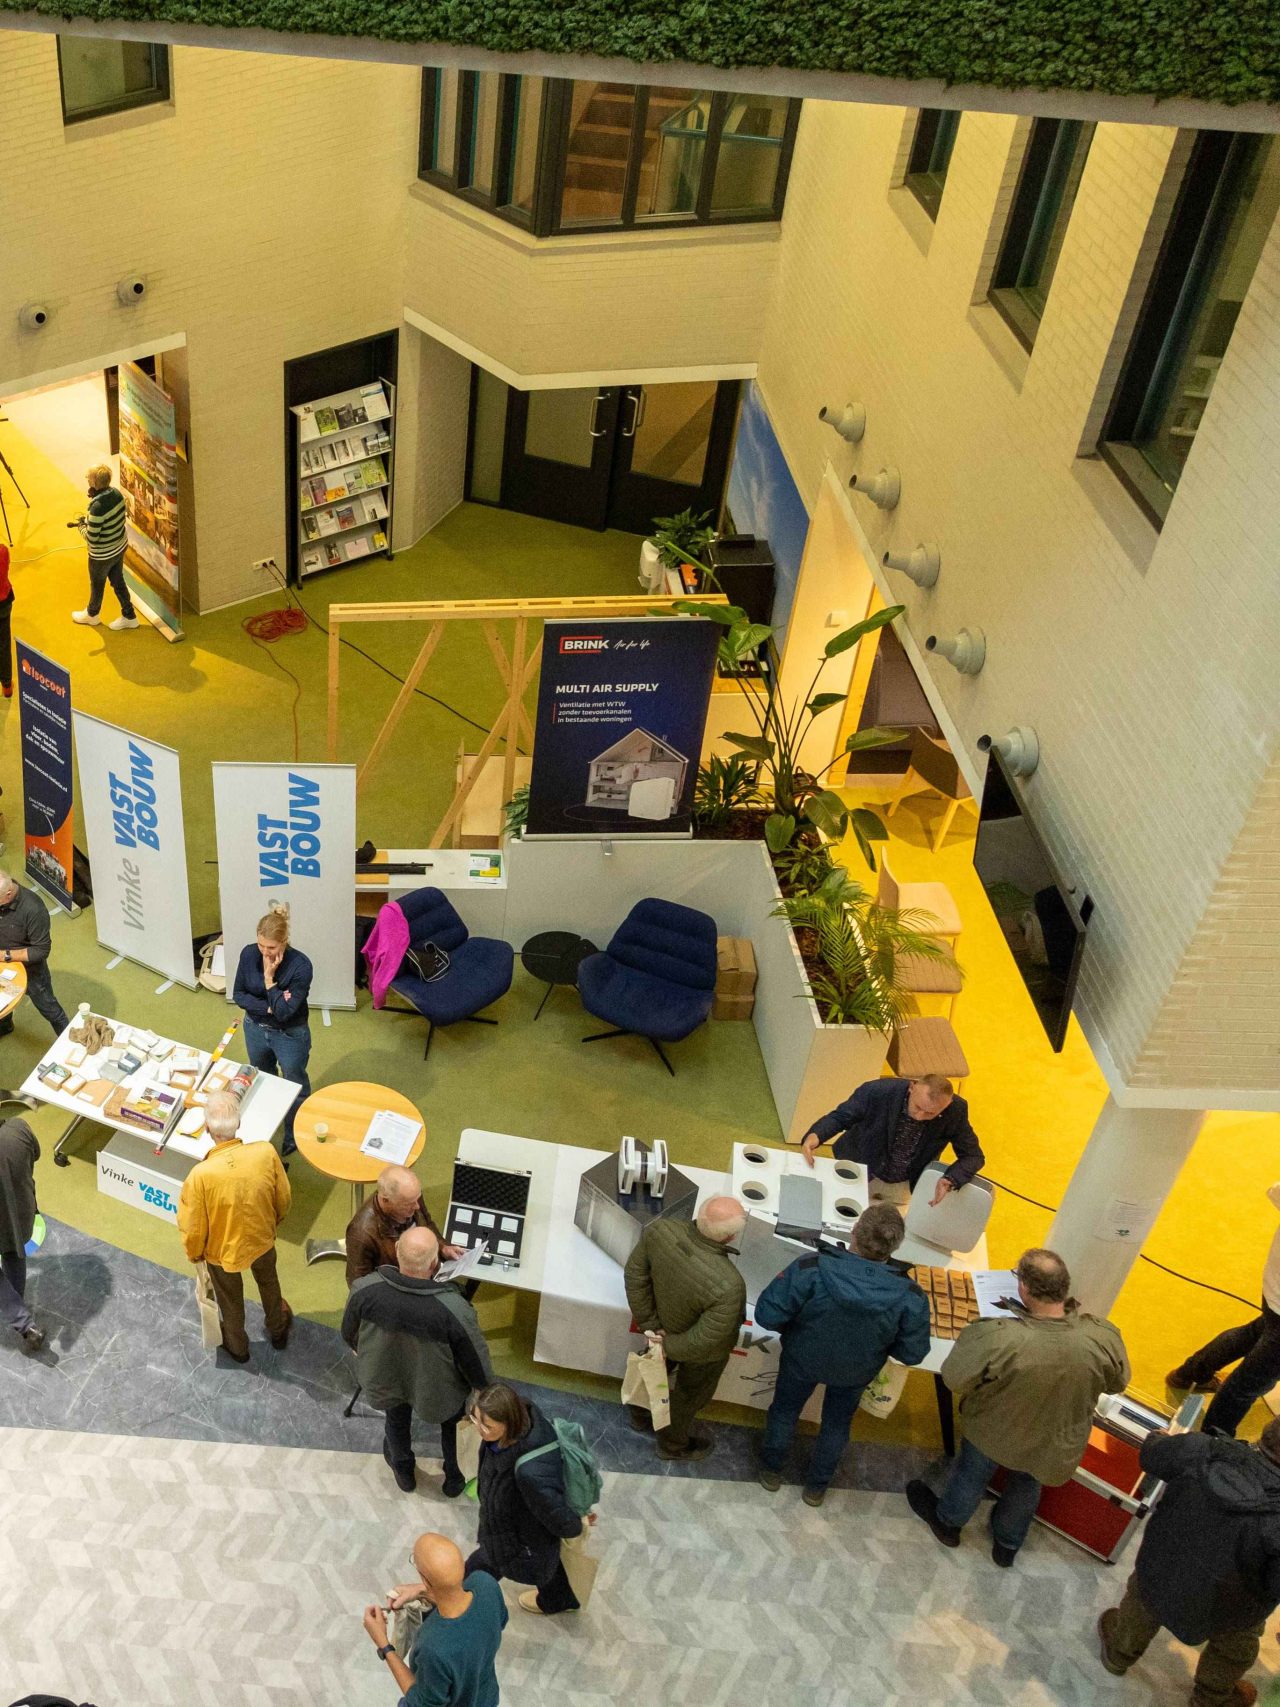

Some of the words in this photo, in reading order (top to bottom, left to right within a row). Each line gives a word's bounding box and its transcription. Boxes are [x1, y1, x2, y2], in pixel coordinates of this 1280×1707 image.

[564, 639, 610, 650] BRINK
[32, 667, 66, 698] Isocoat
[556, 684, 589, 694] MULTI
[592, 684, 613, 693] AIR
[615, 683, 659, 693] SUPPLY
[108, 771, 137, 849] VAST
[128, 740, 160, 851] BOUW
[288, 772, 321, 878] BOUW
[257, 813, 290, 888] VAST
[116, 857, 141, 931] Vinke
[101, 1165, 135, 1187] Vinke
[138, 1181, 171, 1202] VAST
